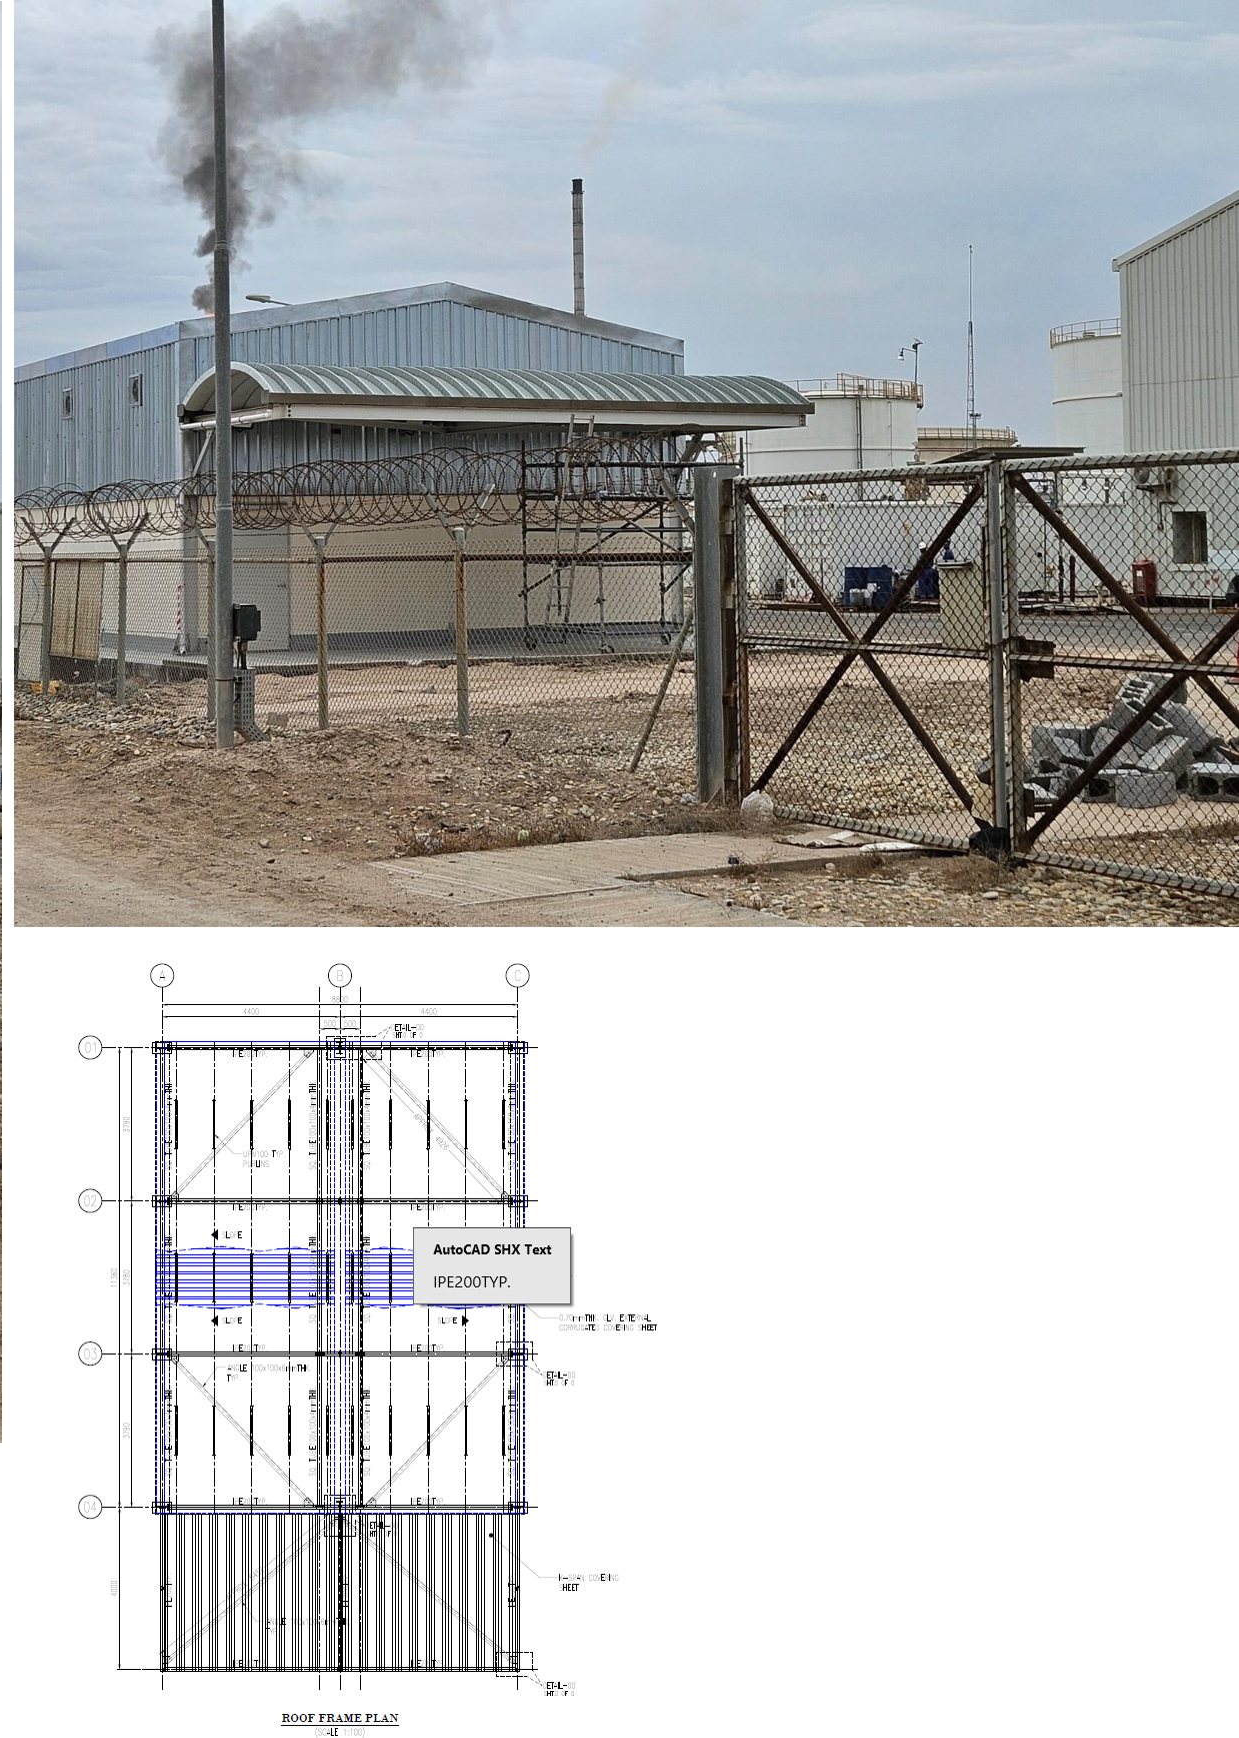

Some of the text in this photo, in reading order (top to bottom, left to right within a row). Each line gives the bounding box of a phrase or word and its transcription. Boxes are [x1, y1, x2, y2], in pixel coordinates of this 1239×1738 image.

[158, 970, 166, 982] A
[336, 970, 344, 982] B
[514, 970, 522, 982] C
[84, 1042, 97, 1053] 01
[435, 1136, 450, 1150] 4926
[84, 1195, 97, 1207] 02
[222, 1231, 242, 1239] SLOPE
[433, 1244, 552, 1256] AutoCAD SHX Text
[433, 1276, 511, 1288] IPE200TYP.
[222, 1317, 242, 1325] SLOPE
[84, 1348, 97, 1360] 03
[227, 1374, 240, 1382] TYP.
[84, 1501, 97, 1513] 04
[559, 1583, 579, 1591] SHEET
[281, 1714, 399, 1722] ROOF FRAME PLAN
[315, 1727, 365, 1738] (SCALE 1:100)
